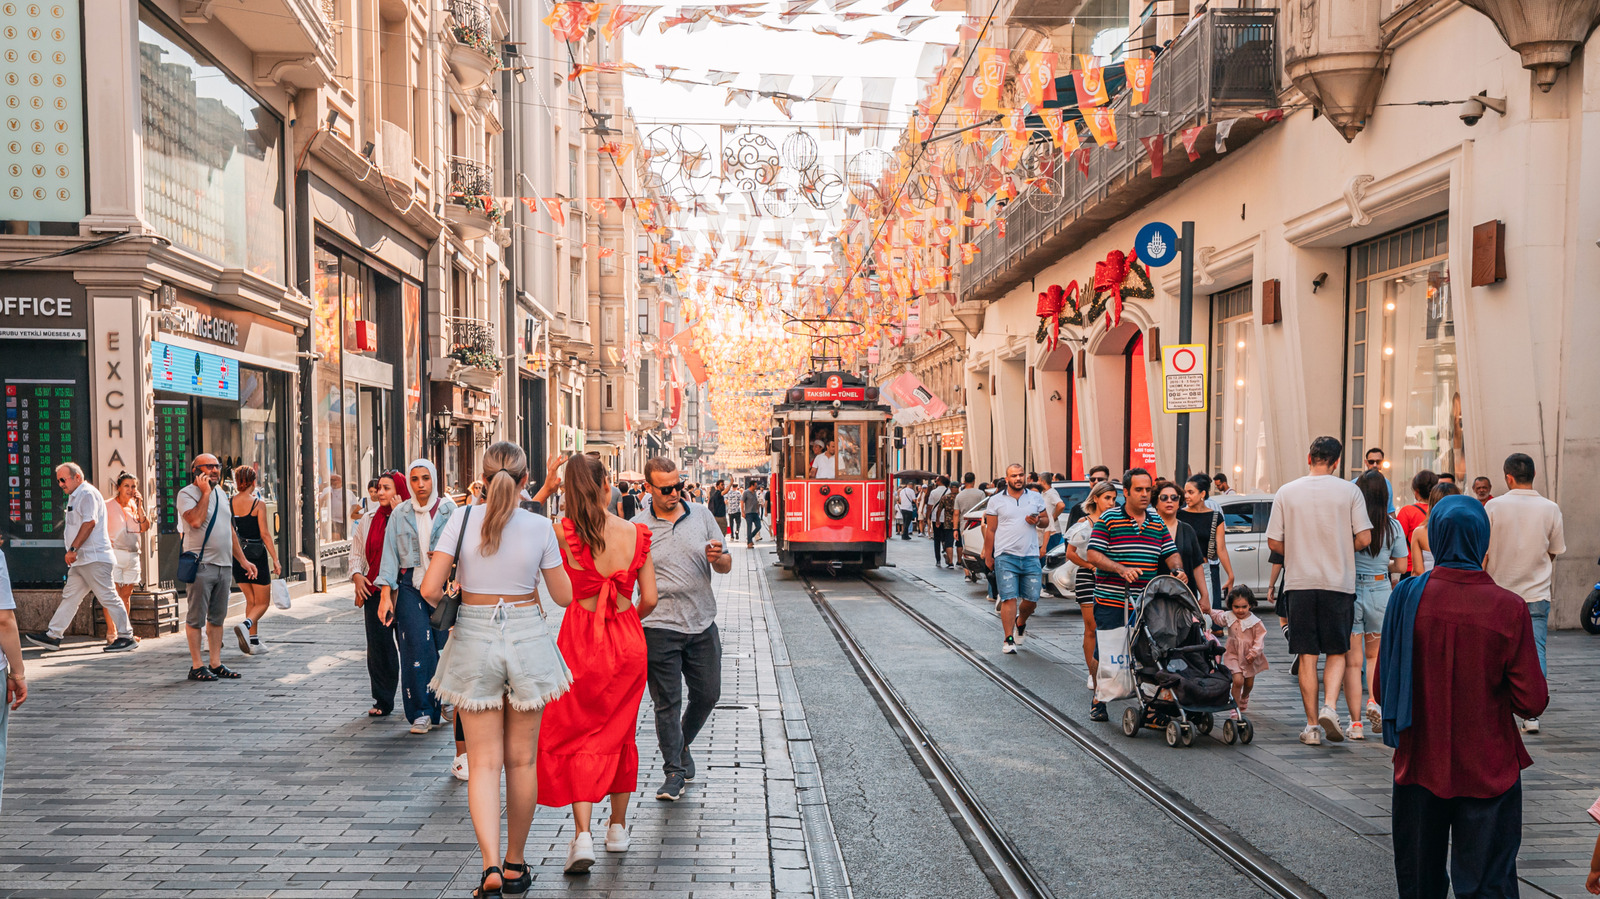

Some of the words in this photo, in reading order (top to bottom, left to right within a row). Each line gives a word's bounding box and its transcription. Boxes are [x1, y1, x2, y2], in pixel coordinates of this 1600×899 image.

[0, 297, 72, 316] FFICE
[180, 307, 213, 339] CHANGE
[213, 317, 239, 346] OFFICE
[830, 377, 840, 388] 3
[105, 331, 126, 498] EXCHAN
